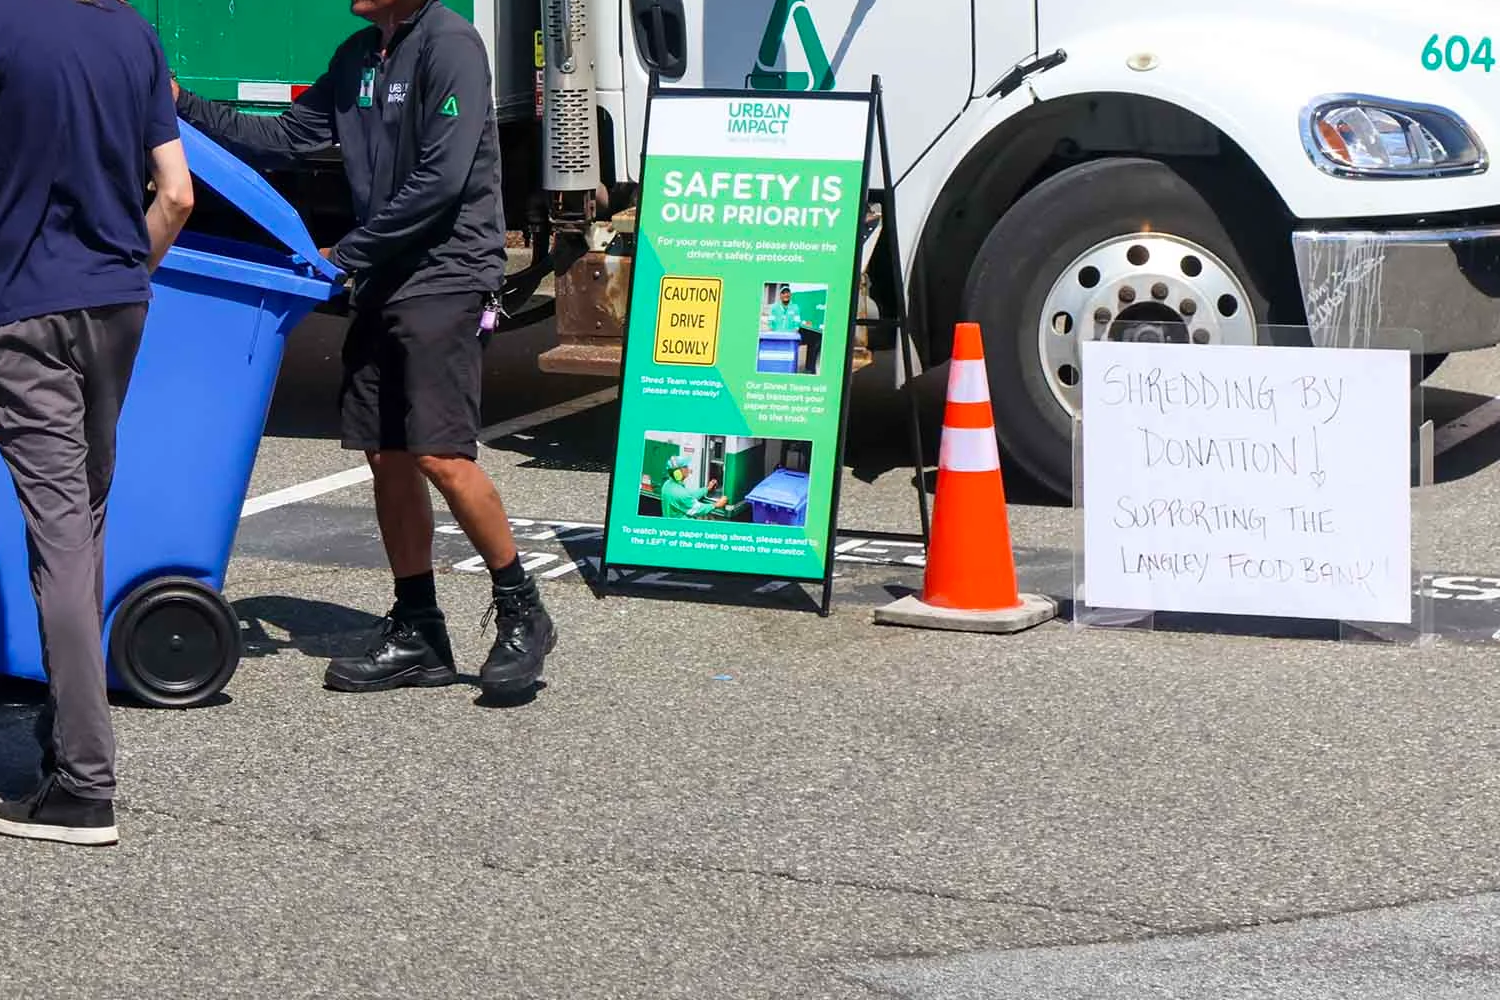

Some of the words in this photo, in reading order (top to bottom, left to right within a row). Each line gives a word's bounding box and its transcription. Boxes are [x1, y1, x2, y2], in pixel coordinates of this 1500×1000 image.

[1421, 33, 1496, 72] 604
[728, 103, 791, 118] URBAN
[727, 119, 789, 134] IMPACT
[663, 171, 799, 201] SAFETY
[811, 175, 843, 202] IS
[661, 203, 715, 223] OUR
[722, 207, 841, 229] PRIORITY
[658, 236, 674, 246] For
[676, 239, 698, 249] your
[700, 240, 721, 248] own
[664, 286, 718, 303] CAUTION
[670, 313, 706, 329] DRIVE
[661, 339, 709, 355] SLOWLY
[1100, 364, 1277, 426] SHREDDING
[1292, 375, 1343, 425] BY
[1113, 495, 1267, 541] SUPPORTING
[1280, 506, 1336, 534] THE
[1119, 545, 1209, 584] LANGLEY
[1221, 552, 1294, 583] FOOD
